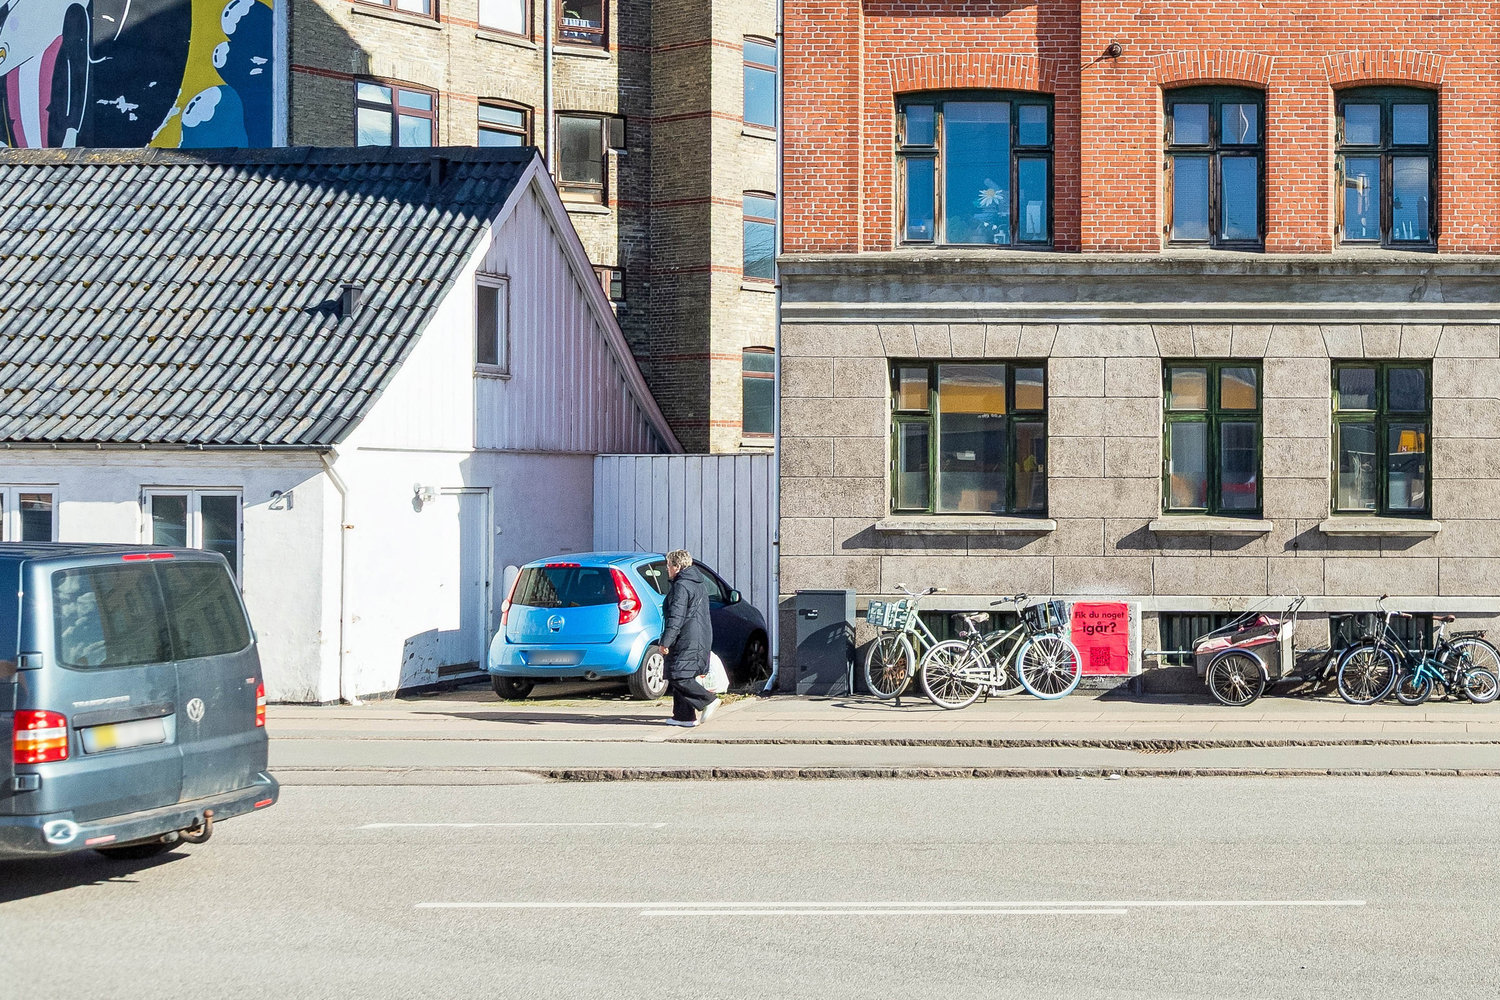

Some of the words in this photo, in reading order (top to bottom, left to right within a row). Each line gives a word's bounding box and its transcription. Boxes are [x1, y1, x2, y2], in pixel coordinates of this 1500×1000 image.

[268, 490, 294, 511] 21
[1089, 611, 1100, 619] du
[1102, 612, 1124, 620] noget
[1082, 621, 1117, 636] igår?
